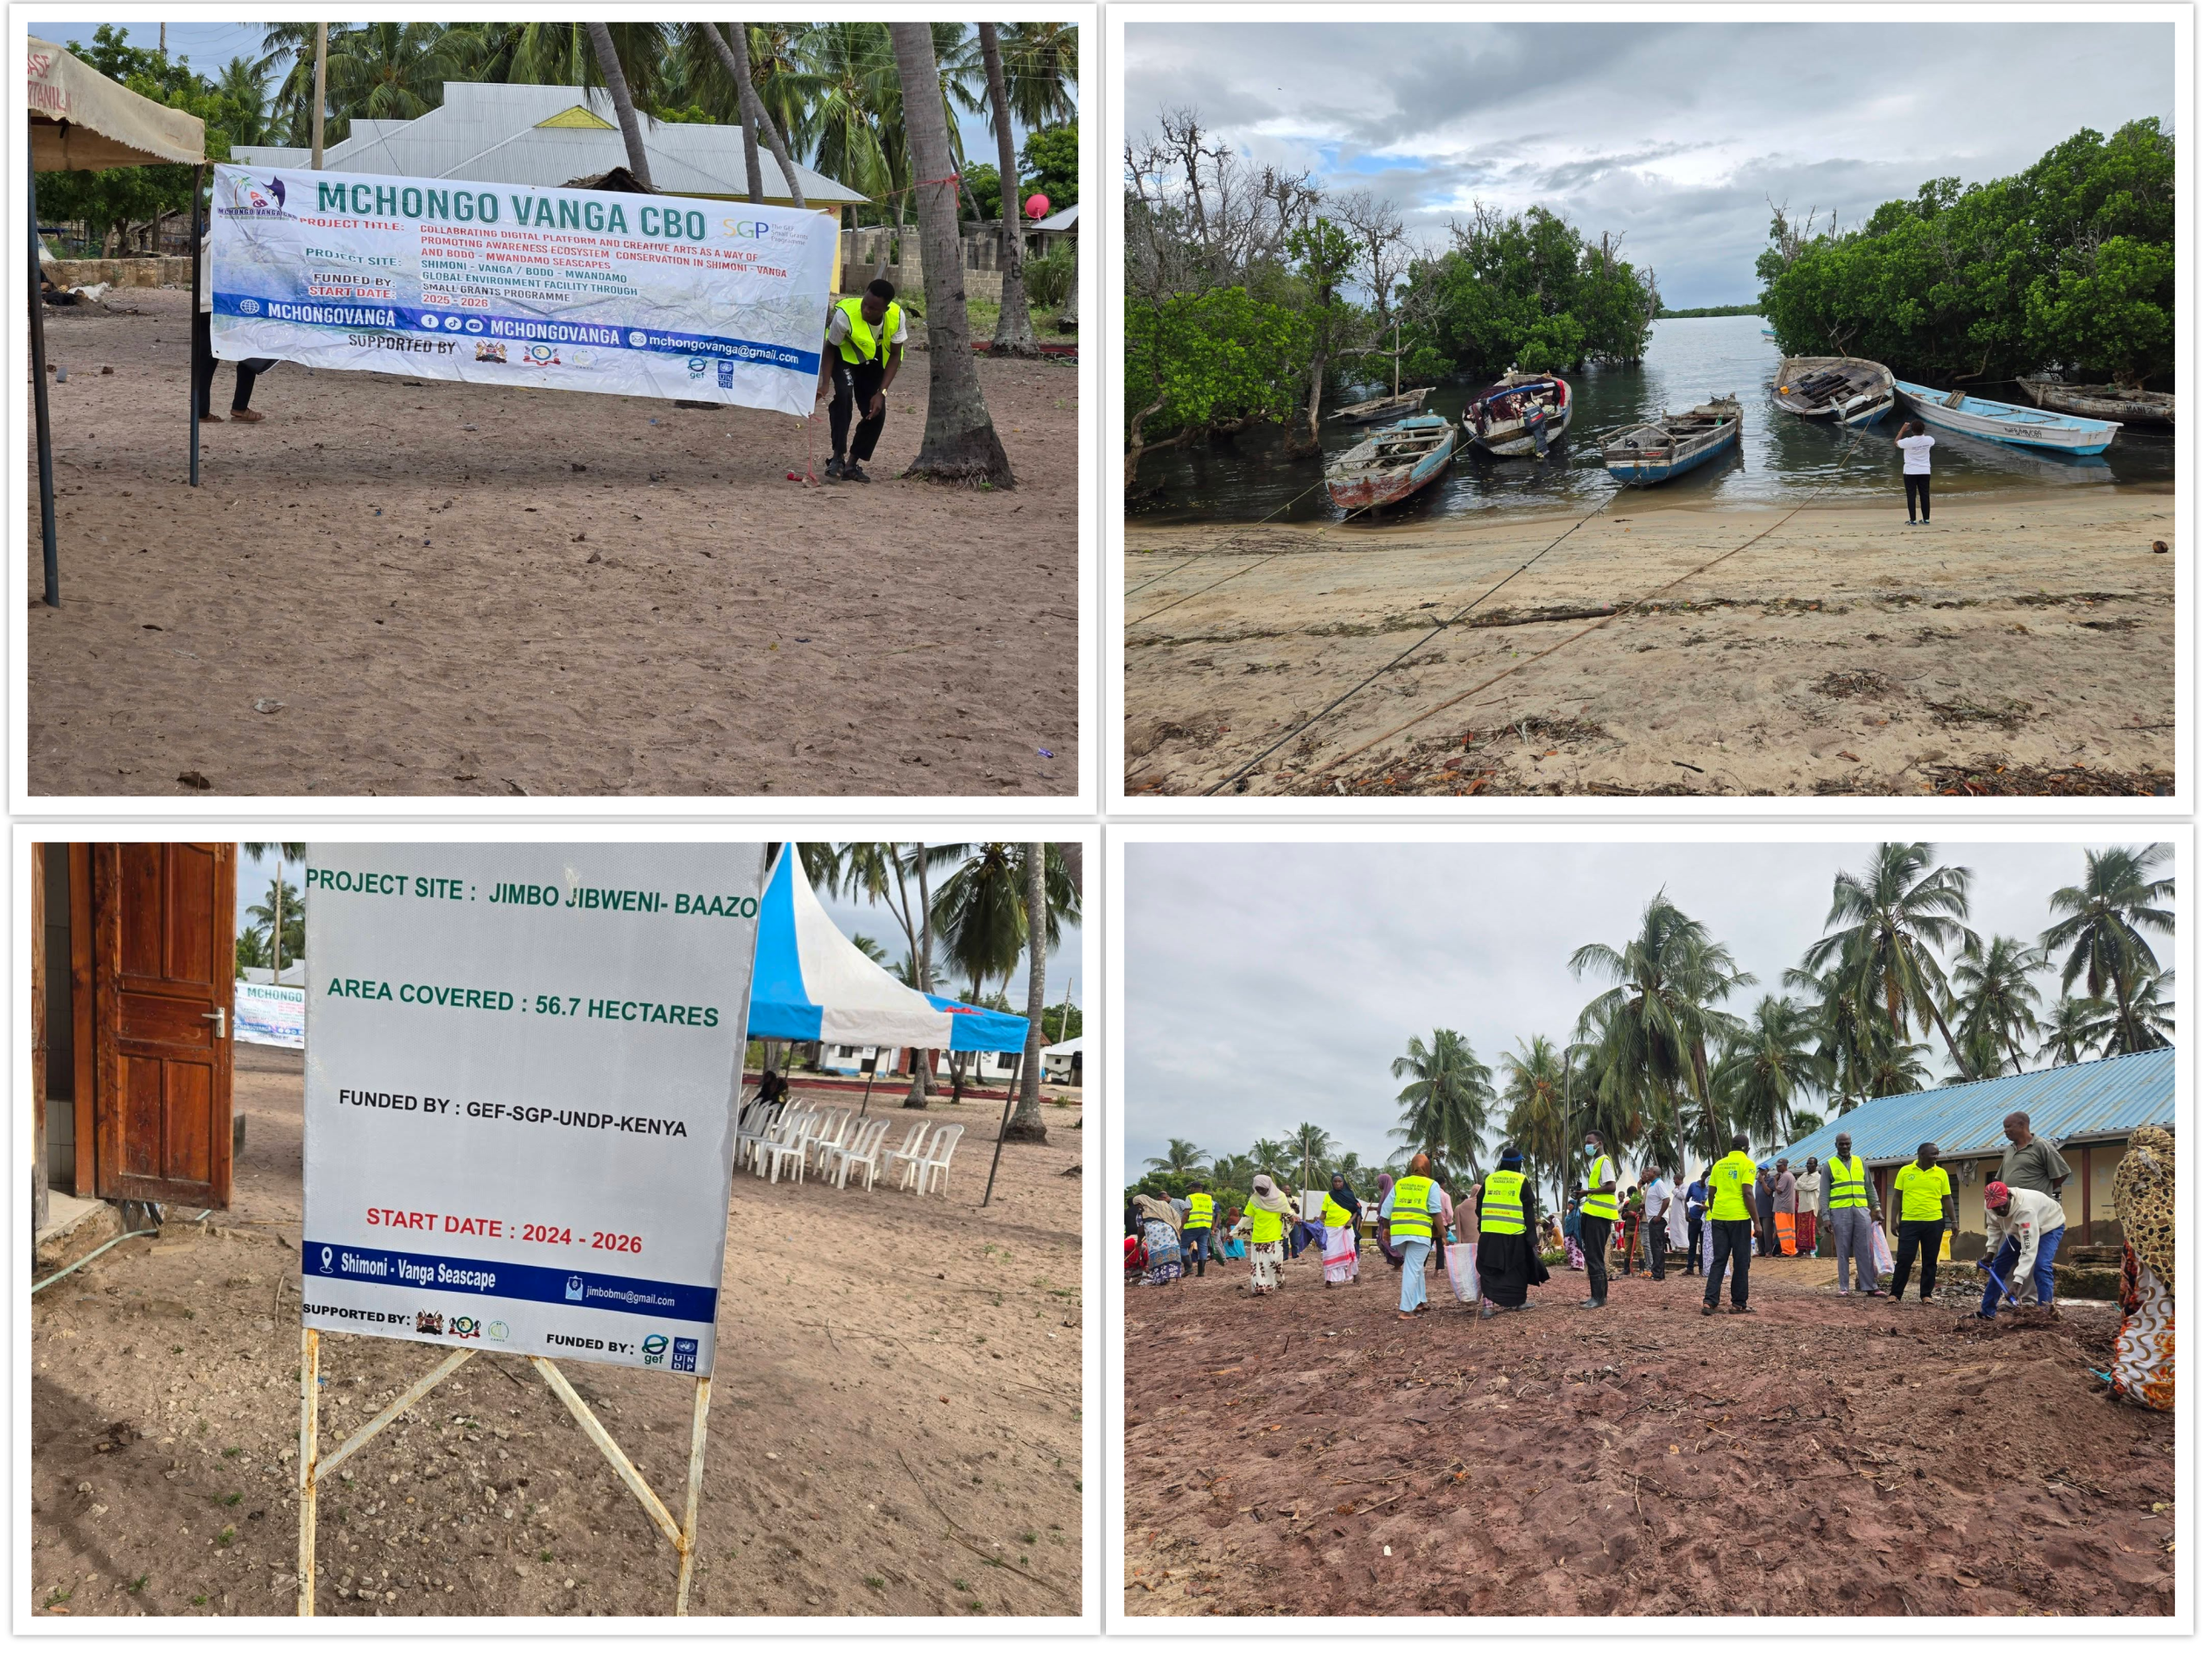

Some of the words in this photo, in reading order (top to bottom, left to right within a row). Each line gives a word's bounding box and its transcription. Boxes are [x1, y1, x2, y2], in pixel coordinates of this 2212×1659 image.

[28, 53, 49, 79] ASE
[218, 207, 255, 216] MCHONGO
[317, 181, 500, 225] MCHONGO
[511, 194, 629, 234] VANGA
[640, 207, 706, 241] CBO
[300, 218, 359, 228] PROJECT
[363, 220, 404, 231] TITLE:
[723, 218, 769, 239] SGP
[420, 225, 498, 238] COLLABRATING
[501, 231, 540, 241] DIGITAL
[543, 234, 596, 245] PLATFORM
[600, 238, 620, 248] AND
[623, 240, 670, 252] CREATIVE
[673, 245, 697, 255] ARTS
[700, 247, 712, 257] AS
[715, 249, 721, 257] A
[723, 250, 744, 260] WAY
[747, 252, 758, 262] OF
[771, 236, 806, 246] Programme
[789, 232, 808, 240] Grants
[306, 248, 364, 264] PROJECT
[368, 257, 402, 266] SITE:
[421, 236, 483, 248] PROMOTING
[486, 241, 548, 253] AWARENESS
[550, 245, 609, 258] ECOSYSTEM
[616, 251, 690, 266] CONSERVATION
[694, 258, 703, 267] IN
[706, 260, 747, 272] SHIMONI
[757, 266, 787, 277] VANGA
[421, 248, 443, 257] AND
[447, 249, 474, 259] BODO
[486, 252, 550, 265] MWANDAMO
[553, 257, 611, 270] SEASCAPES
[314, 273, 370, 285] FUNDED
[375, 277, 396, 288] BY:
[421, 260, 467, 270] SHIMONI
[478, 264, 513, 274] VANGA
[517, 266, 522, 275] /
[525, 267, 554, 277] BODO
[565, 270, 627, 283] MWANDAMO
[309, 286, 353, 296] START
[356, 288, 396, 299] DATE:
[423, 271, 462, 282] GLOBAL
[466, 273, 541, 288] ENVIRONMENT
[544, 280, 588, 291] FACILITY
[590, 283, 638, 296] THROUGH
[423, 283, 459, 293] SMALL
[461, 286, 501, 296] GRANTS
[504, 289, 570, 302] PROGRAMME
[423, 294, 450, 305] 2025
[461, 297, 488, 308] 2026
[268, 302, 396, 327] MCHONGOVANGA
[491, 320, 620, 345] MCHONGOVANGA
[348, 334, 431, 353] SUPPORTED
[438, 340, 455, 355] BY
[649, 336, 799, 365] mchongovanga@gmail.com
[306, 868, 408, 895] PROJECT
[414, 877, 463, 900] SITE
[489, 882, 559, 907] JIMBO
[565, 887, 669, 912] JIBWENI-
[674, 893, 758, 918] BAAZO
[247, 987, 302, 1002] MCHONGO
[327, 977, 393, 1001] AREA
[399, 982, 514, 1011] COVERED
[535, 995, 581, 1017] 56.7
[588, 999, 719, 1027] HECTARES
[340, 1089, 418, 1111] FUNDED
[423, 1097, 450, 1114] BY
[467, 1101, 688, 1137] GEF-SGP-UNDP-KENYA
[366, 1207, 438, 1231] START
[444, 1214, 503, 1237] DATE
[522, 1223, 572, 1245] 2024
[591, 1230, 643, 1254] 2026
[340, 1251, 388, 1277] Shimoni
[397, 1259, 435, 1287] Vanga
[437, 1262, 496, 1289] Seascape
[586, 1285, 675, 1307] jimbobmu@gmail.com
[302, 1303, 385, 1322] SUPPORTED
[388, 1313, 410, 1325] BY:
[546, 1333, 604, 1350] FUNDED
[644, 1353, 664, 1365] gef
